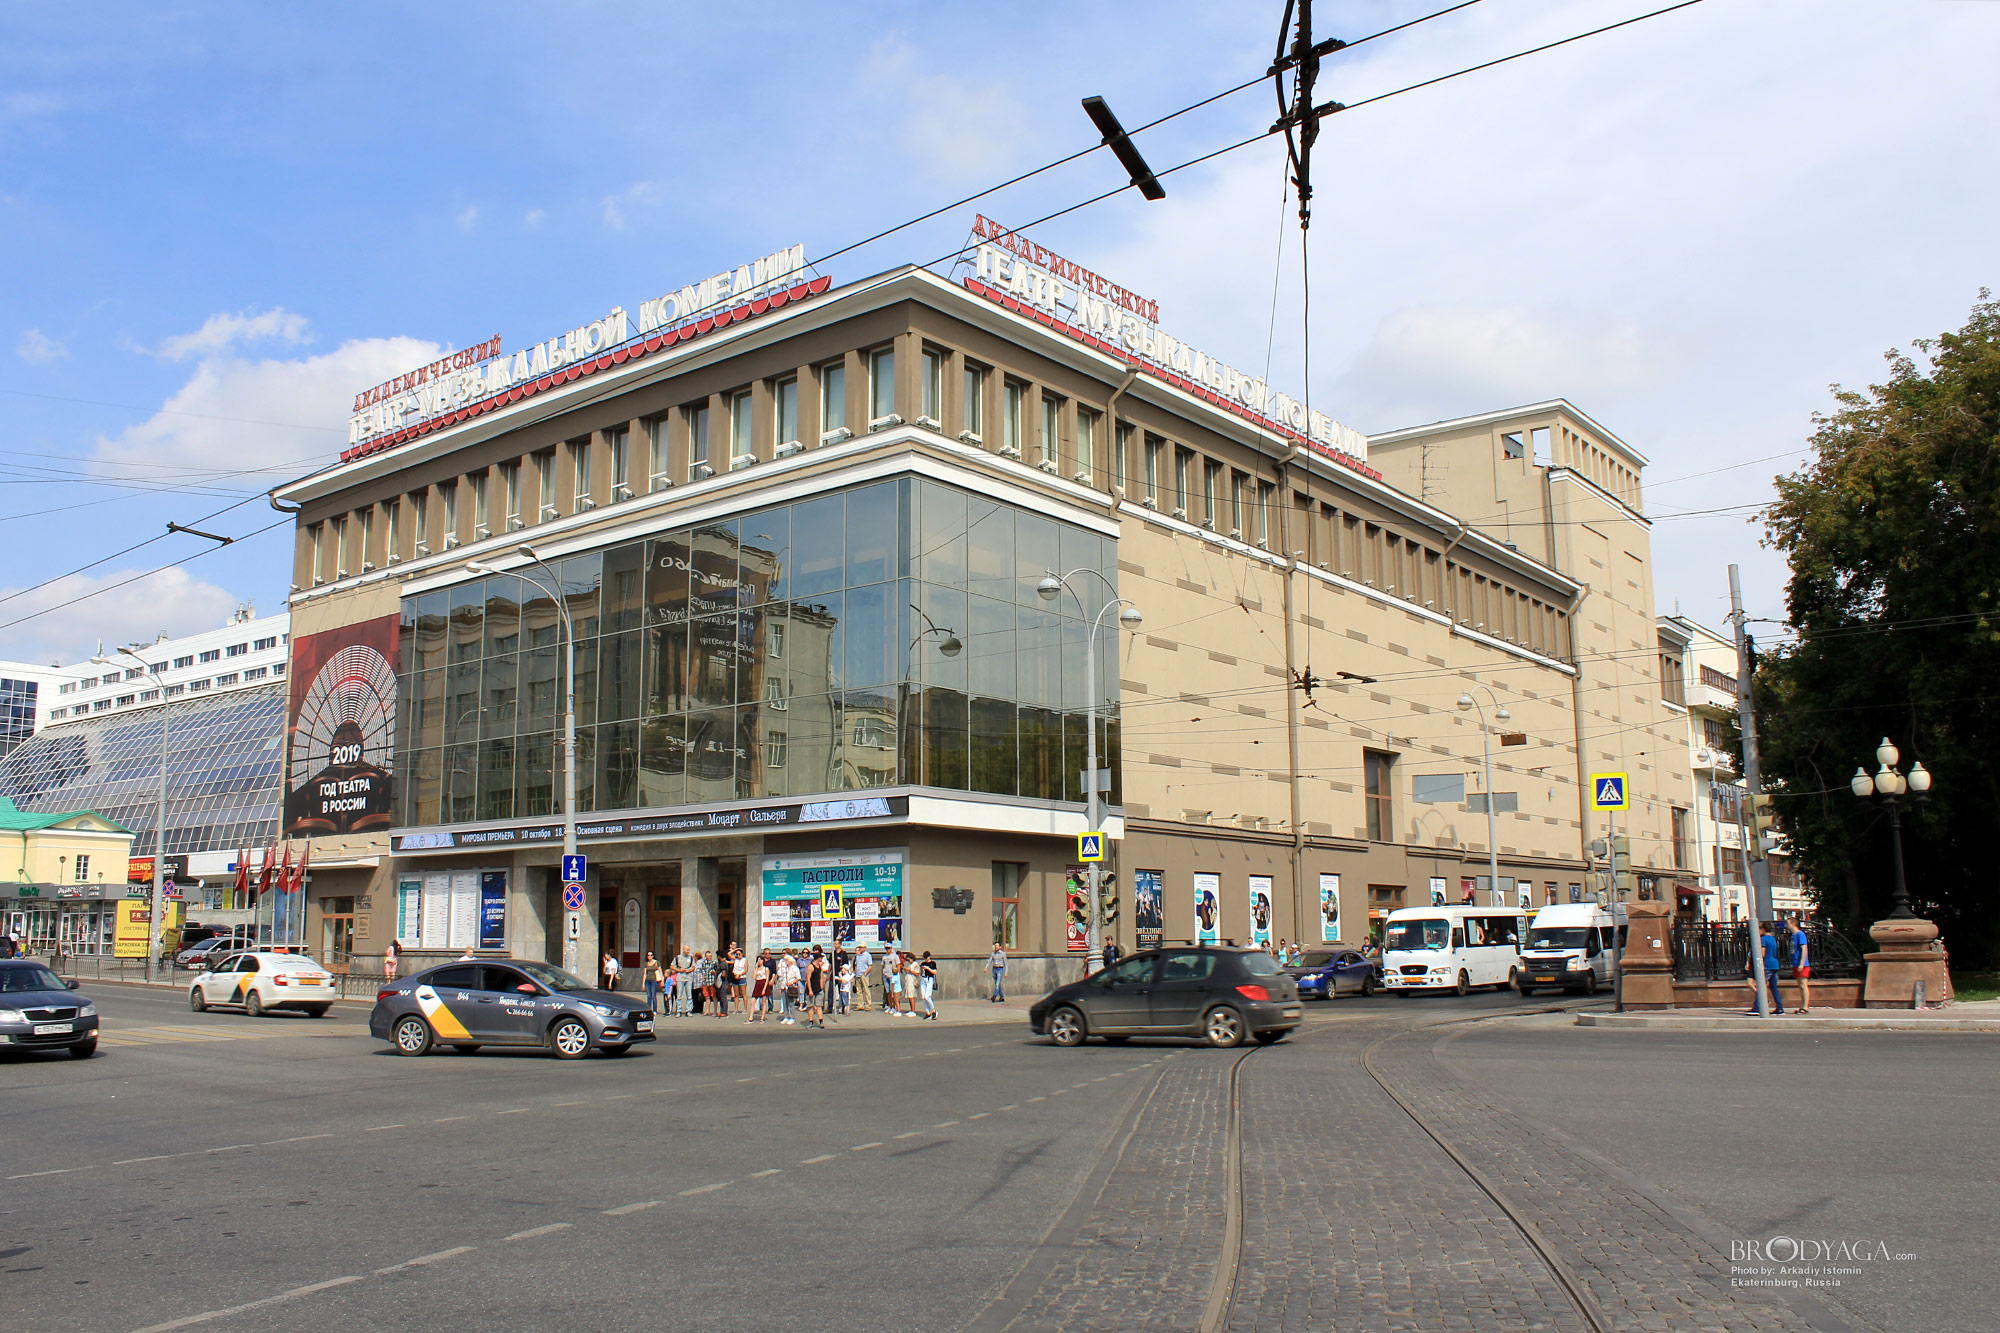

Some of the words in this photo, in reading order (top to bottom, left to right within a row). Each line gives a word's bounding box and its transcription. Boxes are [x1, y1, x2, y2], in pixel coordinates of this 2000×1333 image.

[972, 213, 1159, 324] АКАДЕМИЧЕСКИЙ
[349, 393, 410, 444] ТЕАТР
[418, 306, 628, 419] МУЗЫКАЛЬНОЙ
[639, 242, 804, 336] КОМЕДИИ
[974, 239, 1065, 313] ТЕАТР
[1077, 291, 1269, 414] МУЗЫКАЛЬНОЙ
[1275, 391, 1368, 463] КОМЕДИИ
[353, 332, 502, 411] АКАДЕМИЧЕСКИЙ
[332, 744, 362, 766] 2019
[319, 780, 338, 797] ГОД
[338, 777, 371, 795] ТЕАТРА
[322, 801, 329, 814] В
[329, 797, 367, 814] РОССИИ
[461, 832, 487, 843] МИРОВАЯ
[487, 830, 515, 842] ПРЕМЬЕРА
[521, 829, 528, 839] 10
[529, 829, 551, 839] октября
[577, 825, 605, 836] Основная
[605, 824, 623, 834] сцена
[630, 822, 652, 832] комедия
[656, 821, 669, 831] двух
[669, 818, 704, 830] злодействиях
[707, 812, 740, 826] Моцарт
[750, 809, 787, 824] Сальери
[127, 862, 152, 872] FRIENDS
[802, 868, 865, 884] ГАСТРОЛИ
[874, 866, 897, 876] 10-19
[1140, 934, 1159, 942] ПЕСНИ
[457, 991, 470, 1001] 844
[498, 996, 519, 1006] Яндекс
[520, 997, 536, 1008] Такси
